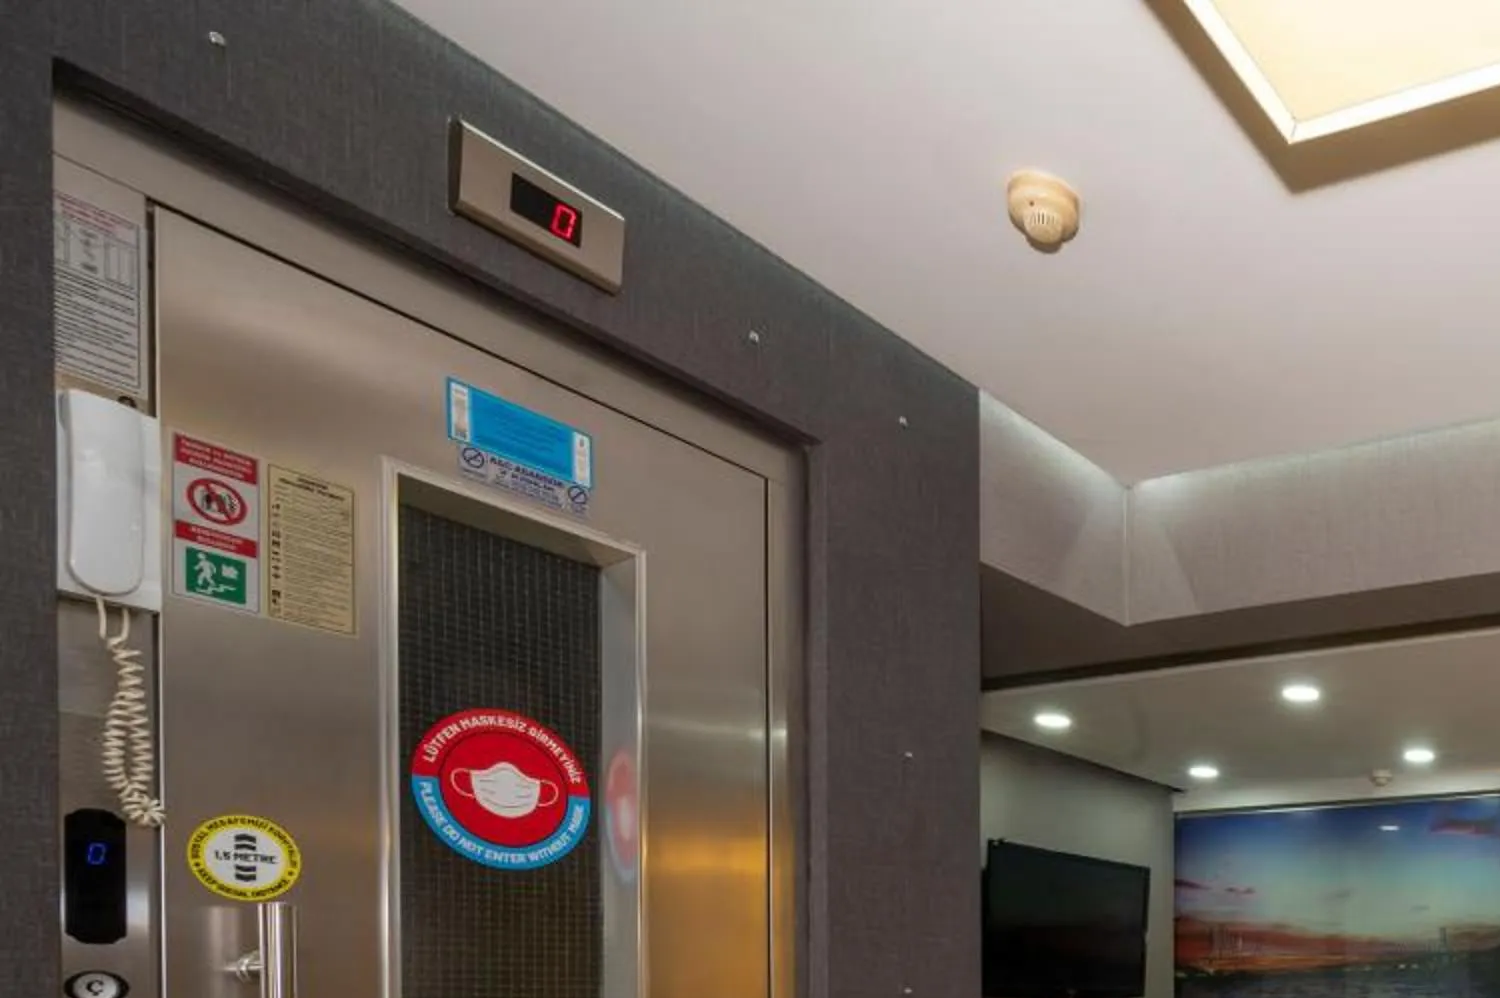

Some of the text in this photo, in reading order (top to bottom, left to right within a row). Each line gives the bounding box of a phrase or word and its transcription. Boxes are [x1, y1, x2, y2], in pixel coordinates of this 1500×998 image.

[549, 202, 577, 240] 0
[422, 722, 461, 763] LÜTFEN
[458, 836, 484, 855] NOT
[484, 848, 526, 863] ENTER
